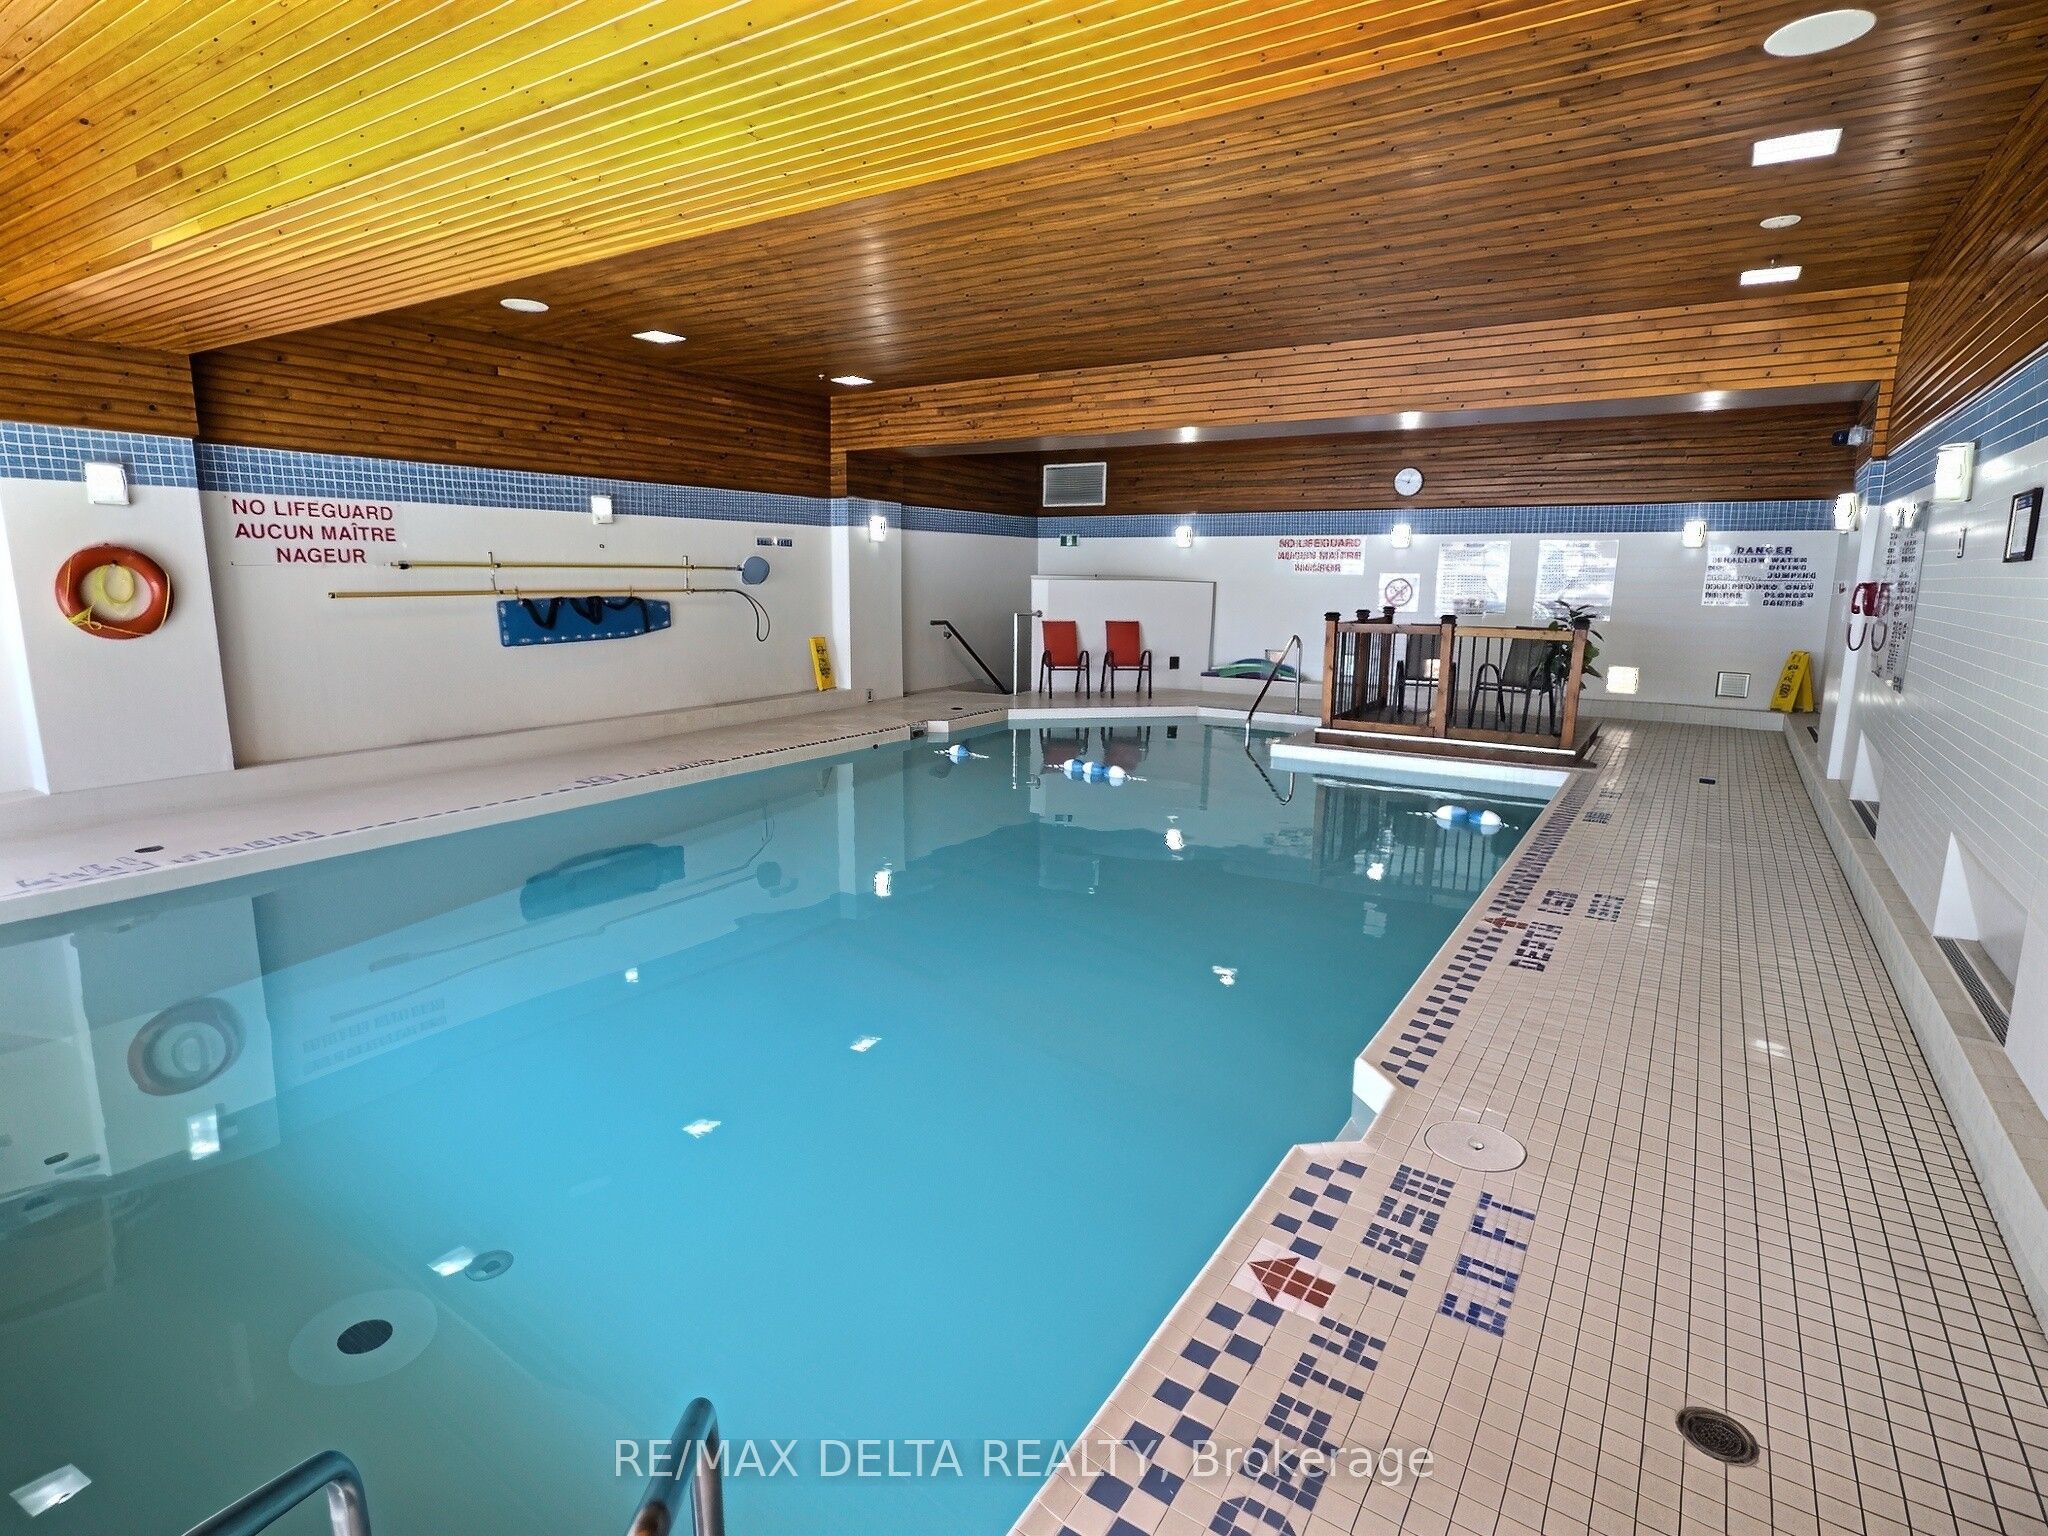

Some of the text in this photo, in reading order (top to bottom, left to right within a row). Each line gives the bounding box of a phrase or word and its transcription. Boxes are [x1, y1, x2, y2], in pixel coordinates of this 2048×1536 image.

[232, 499, 393, 520] NO LIFEGUARD
[235, 522, 396, 542] AUCUN MAÎTRE
[277, 548, 367, 564] NAGEUR
[1736, 546, 1793, 554] DANGER
[1509, 921, 1564, 972] DEPTH
[1468, 1190, 1537, 1251] FT
[1208, 1315, 1387, 1536] DEPTH
